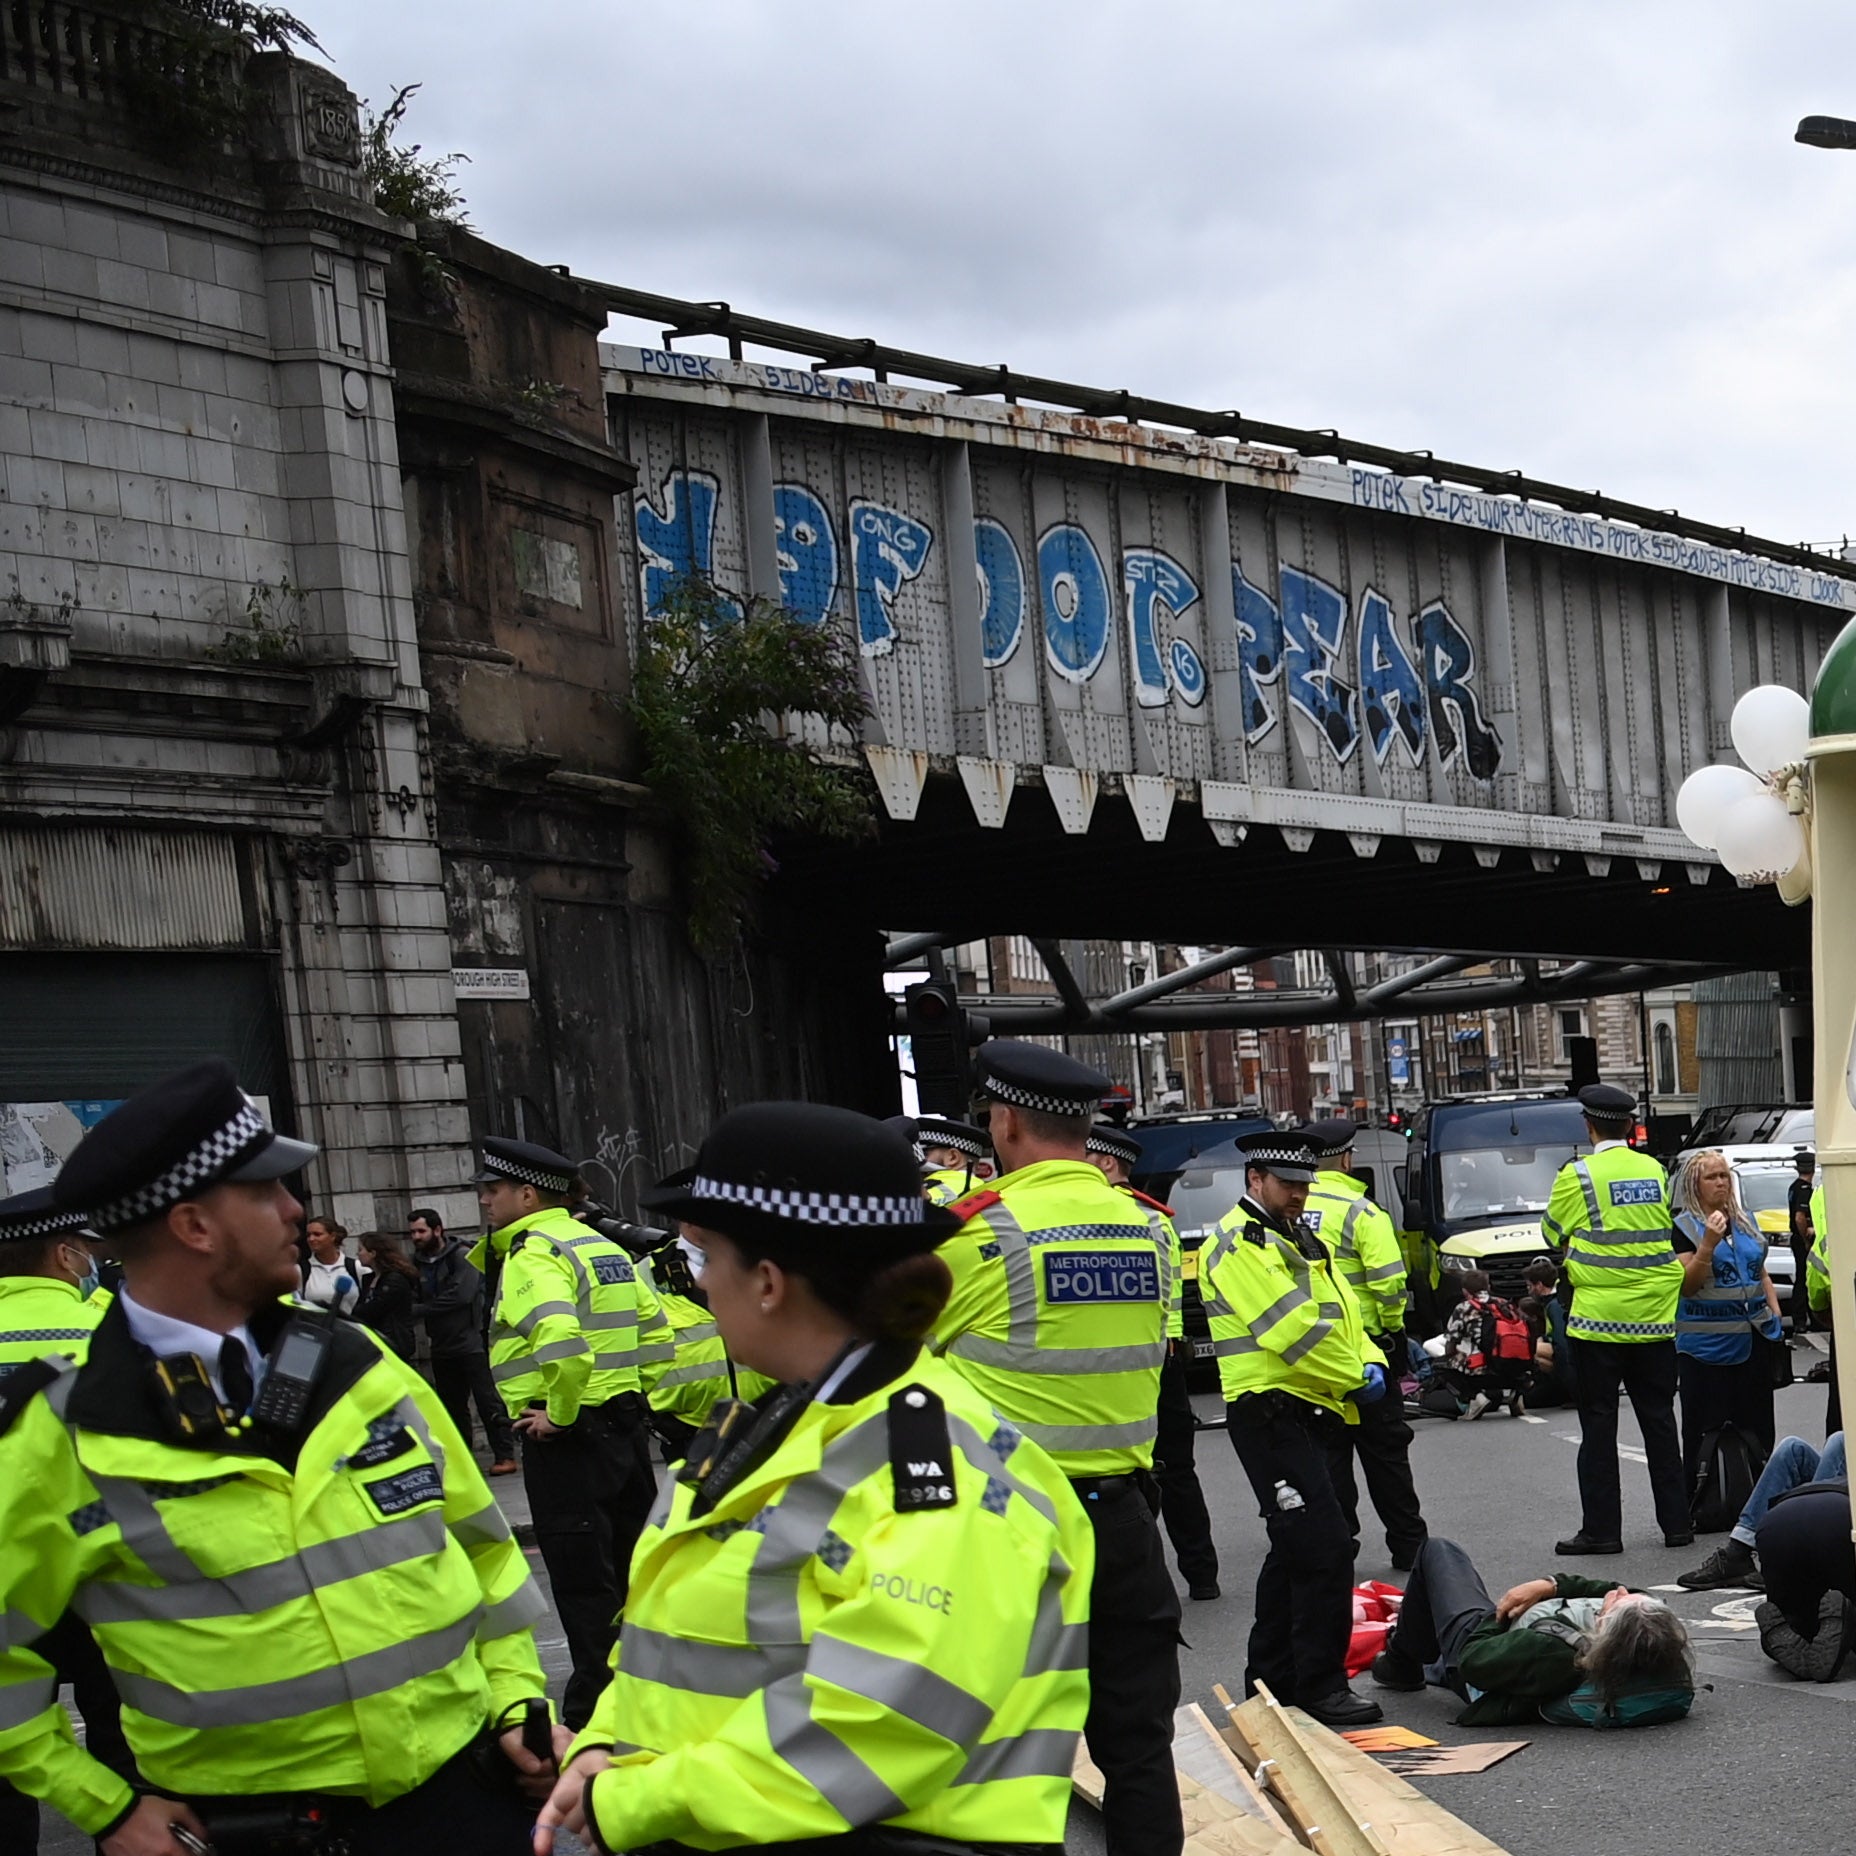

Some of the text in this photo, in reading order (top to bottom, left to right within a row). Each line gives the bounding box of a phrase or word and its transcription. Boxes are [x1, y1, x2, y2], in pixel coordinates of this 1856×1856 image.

[452, 971, 484, 988] OROUGH
[1613, 1188, 1661, 1204] POLICE
[1050, 1256, 1154, 1270] METROPOLITAN
[1050, 1271, 1156, 1298] POLICE
[907, 1460, 945, 1478] WA
[870, 1572, 954, 1616] POLICE
